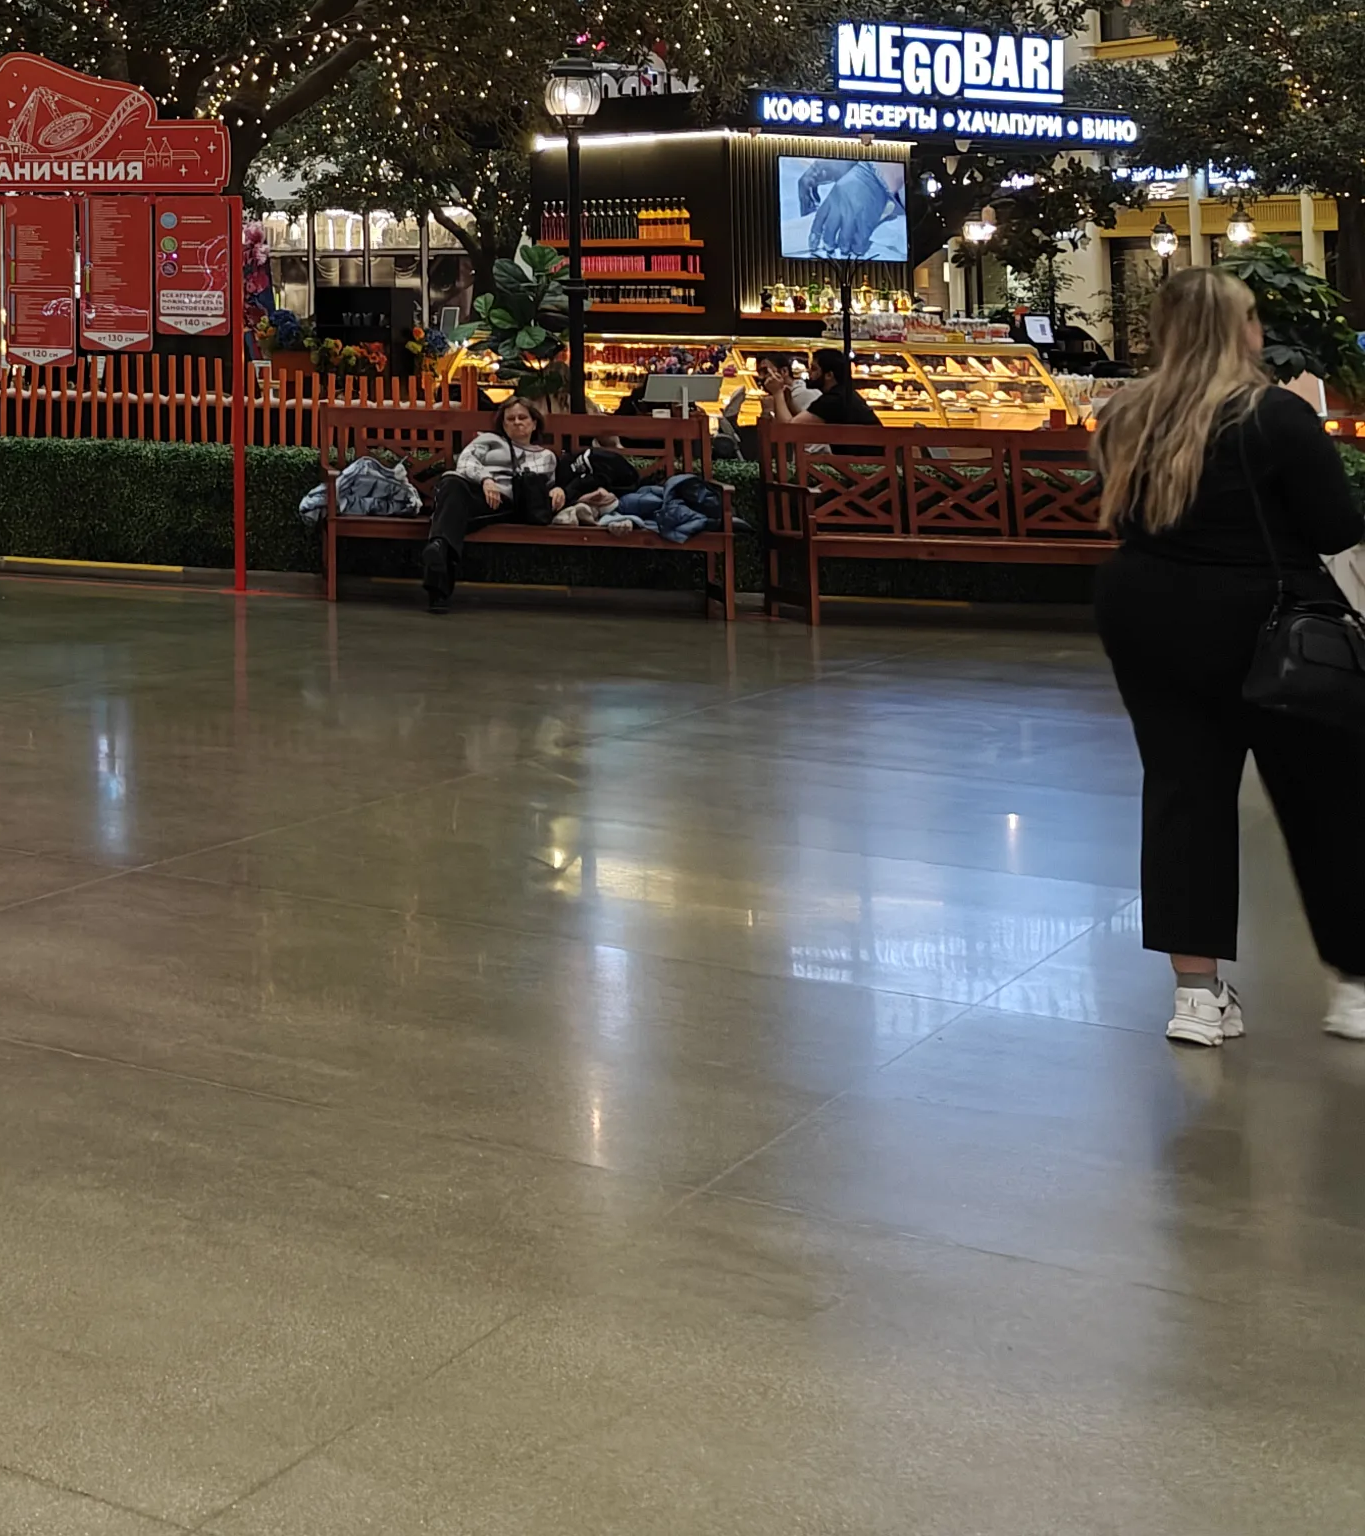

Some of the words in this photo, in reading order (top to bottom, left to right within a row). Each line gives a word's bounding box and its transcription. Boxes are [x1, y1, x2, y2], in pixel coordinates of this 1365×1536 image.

[837, 22, 1065, 101] MEGOBARI
[762, 96, 823, 124] КОФЕ
[844, 101, 937, 130] ДЕСЕРТЫ
[957, 109, 1063, 138] ХАЧАПУРИ
[1081, 117, 1137, 142] ВИНО
[107, 334, 124, 342] 130
[32, 350, 47, 358] 120
